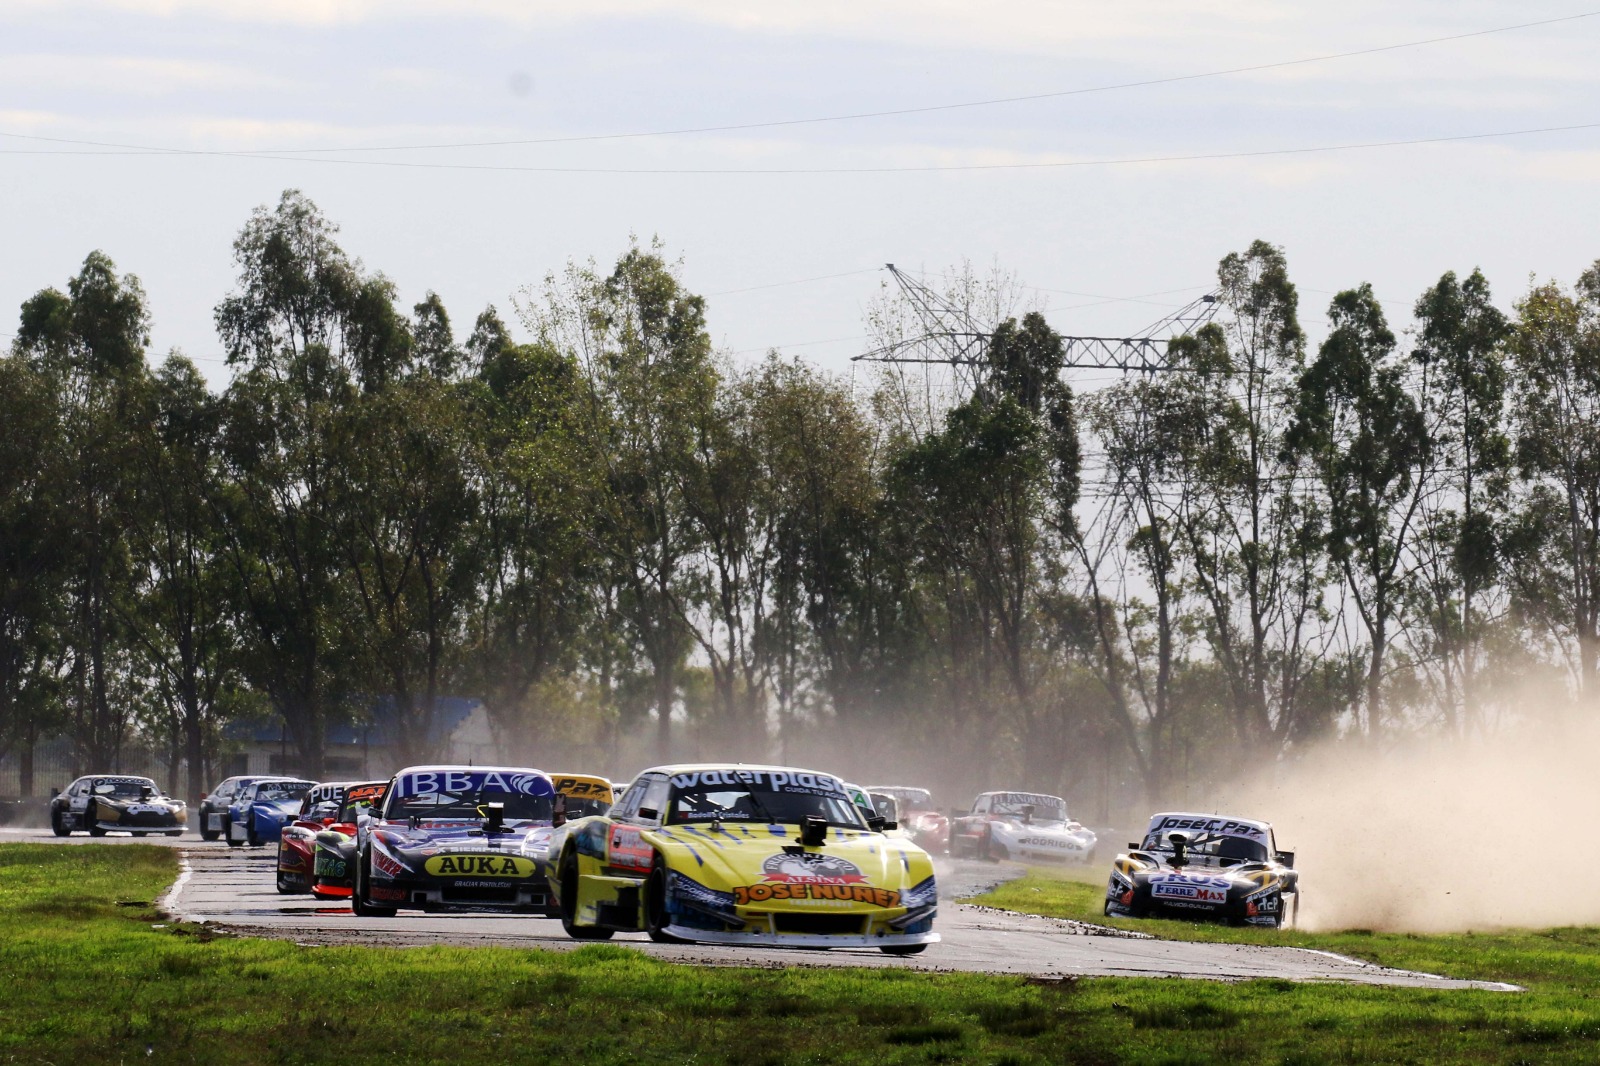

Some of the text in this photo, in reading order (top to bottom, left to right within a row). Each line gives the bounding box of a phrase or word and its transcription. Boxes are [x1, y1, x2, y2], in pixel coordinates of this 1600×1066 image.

[671, 770, 848, 793] waterplast
[785, 786, 811, 794] CUIDA
[1024, 837, 1075, 850] RODRIGO
[438, 856, 520, 875] AUKA
[785, 875, 847, 884] ALSINA
[733, 883, 807, 905] JOSE
